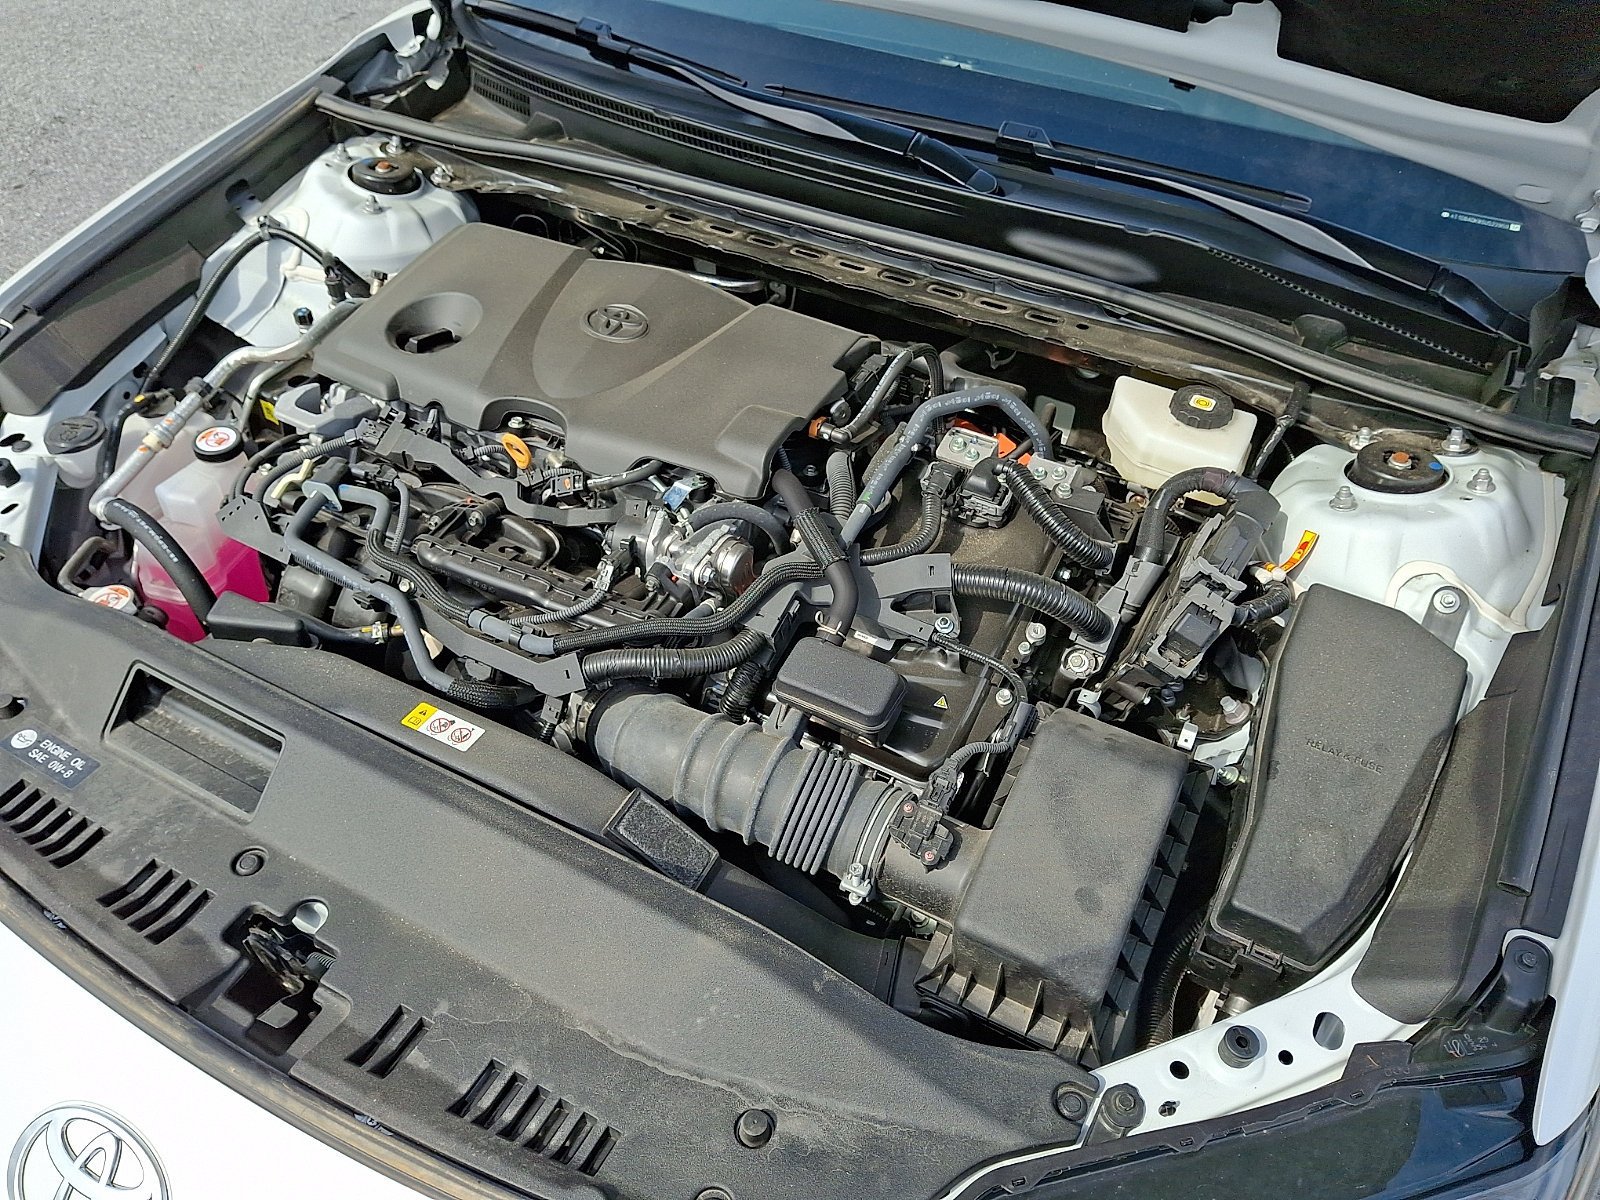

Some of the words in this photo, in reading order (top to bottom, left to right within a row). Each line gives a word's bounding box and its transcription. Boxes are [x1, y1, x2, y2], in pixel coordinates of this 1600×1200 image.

[28, 748, 49, 763] SAE
[48, 760, 74, 779] 0W-8
[40, 739, 72, 761] ENGINE
[70, 758, 86, 771] OIL
[1306, 739, 1342, 757] RELAY
[1354, 756, 1384, 774] FUSE
